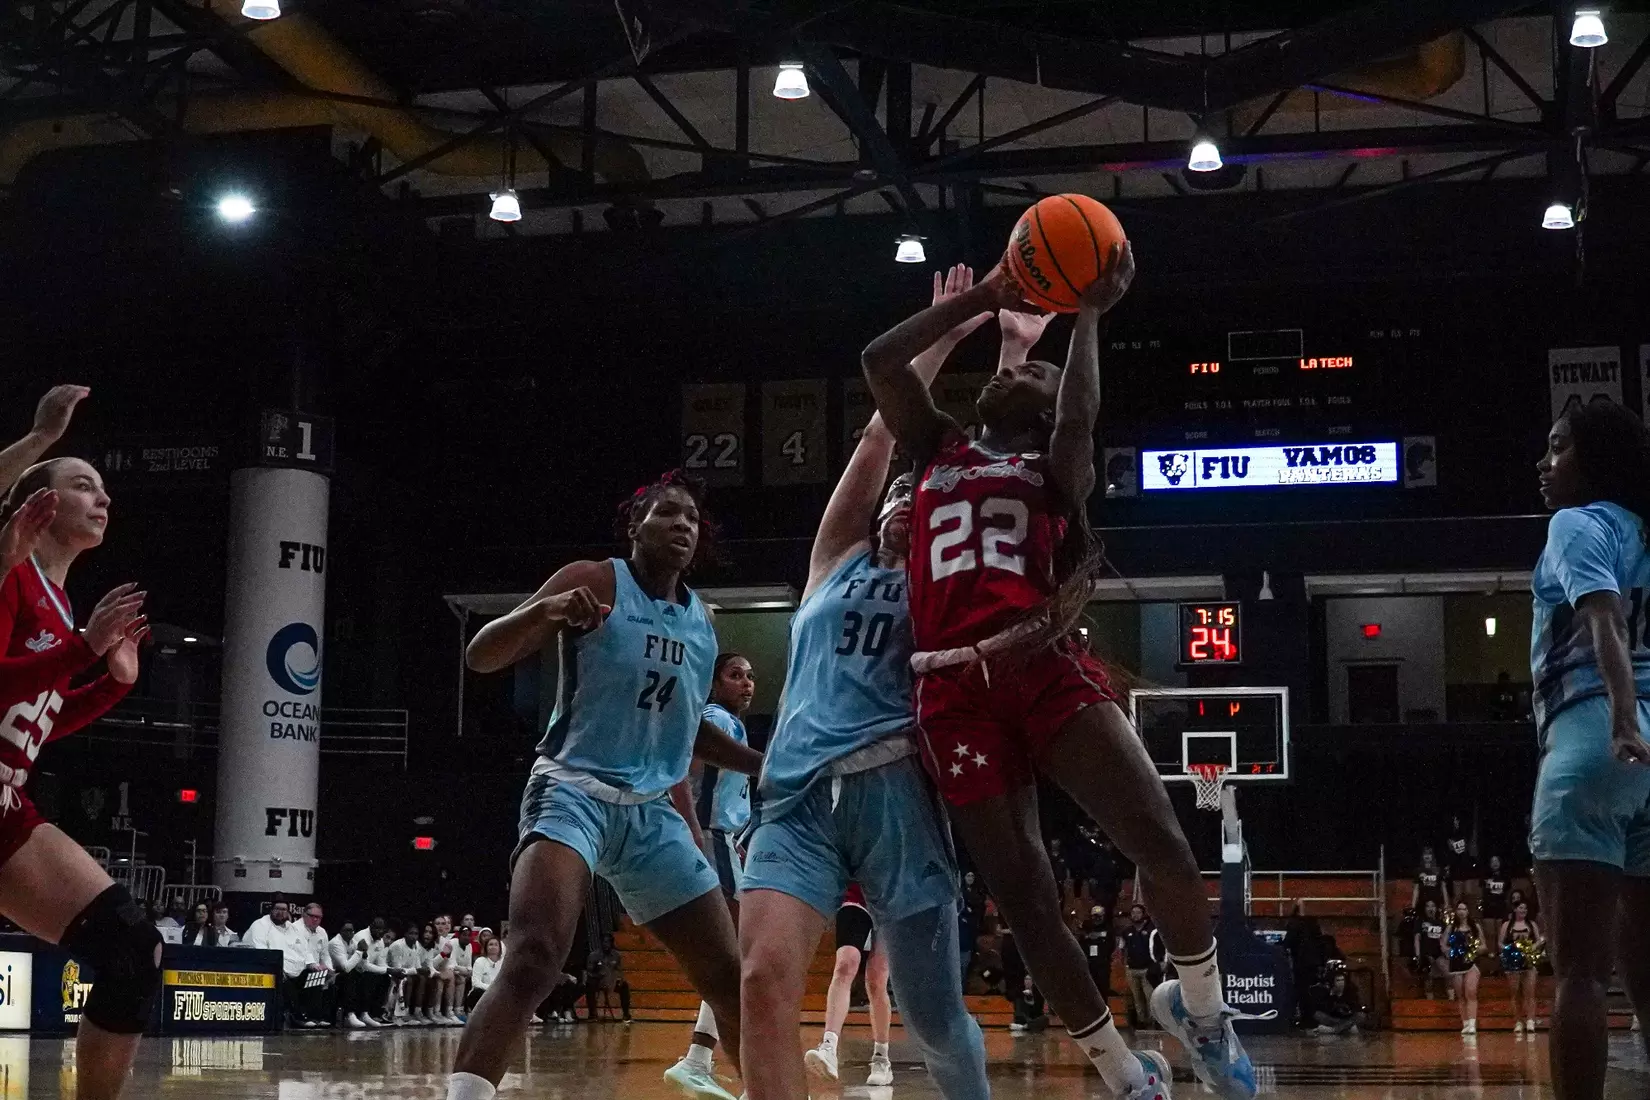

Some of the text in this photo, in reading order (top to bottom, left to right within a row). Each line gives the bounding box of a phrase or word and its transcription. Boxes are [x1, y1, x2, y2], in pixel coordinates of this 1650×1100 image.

[1017, 219, 1051, 291] Wilson
[1190, 362, 1220, 374] FIU
[1300, 356, 1353, 369] LA TECH
[1552, 361, 1618, 384] STEWART
[142, 446, 219, 460] RESTROOMS
[296, 421, 316, 461] 1
[684, 432, 741, 468] 22
[780, 430, 807, 466] 4
[173, 458, 211, 470] LEVEL
[1201, 456, 1251, 480] FIU
[1282, 445, 1377, 467] VAMOS
[1278, 466, 1382, 483] PANTERAS
[929, 498, 1029, 582] 22
[278, 541, 324, 574] FIU
[842, 578, 902, 603] FIU
[1197, 607, 1235, 626] 7:15
[834, 611, 896, 656] 30
[1191, 627, 1231, 659] 24
[644, 634, 686, 666] FIU
[637, 671, 677, 712] 24
[262, 700, 320, 722] OCEAN
[0, 689, 64, 763] 25
[270, 722, 318, 743] BANK
[265, 808, 314, 838] FIU
[1226, 974, 1276, 991] Baptist
[1226, 990, 1273, 1004] Health
